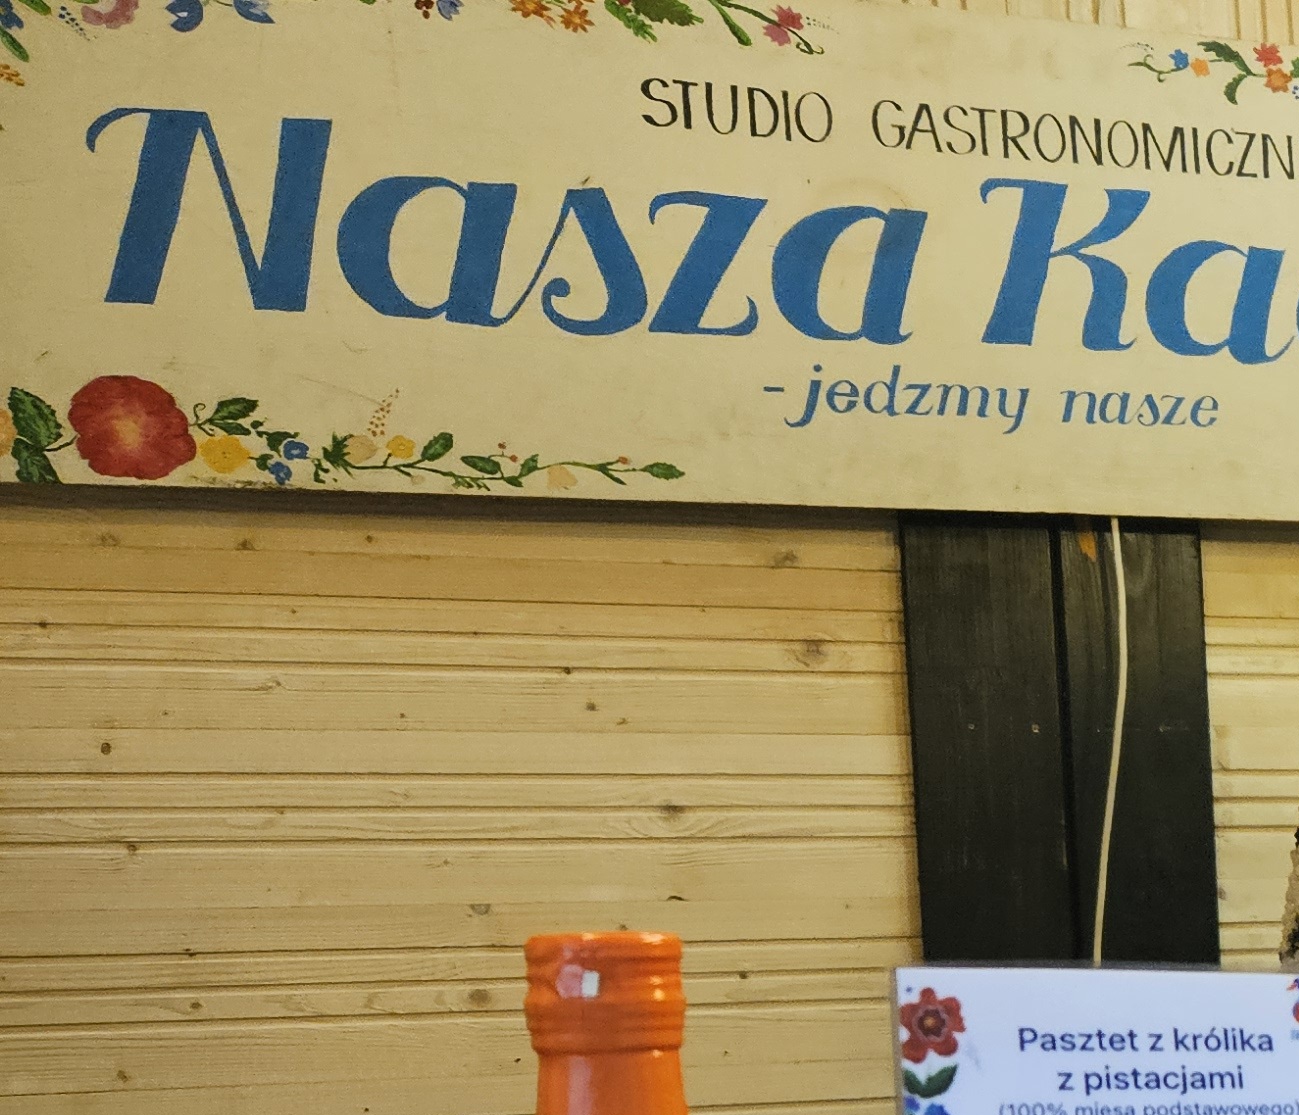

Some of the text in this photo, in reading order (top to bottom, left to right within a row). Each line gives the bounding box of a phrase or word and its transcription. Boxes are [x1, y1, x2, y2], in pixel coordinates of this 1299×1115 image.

[640, 78, 833, 143] STUDIO
[85, 107, 929, 345] Nasza
[1060, 387, 1219, 427] nasze
[1018, 1027, 1139, 1052] Pasztet
[1149, 1033, 1164, 1051] z
[1173, 1026, 1274, 1052] królika
[1057, 1065, 1244, 1096] z pistacjami
